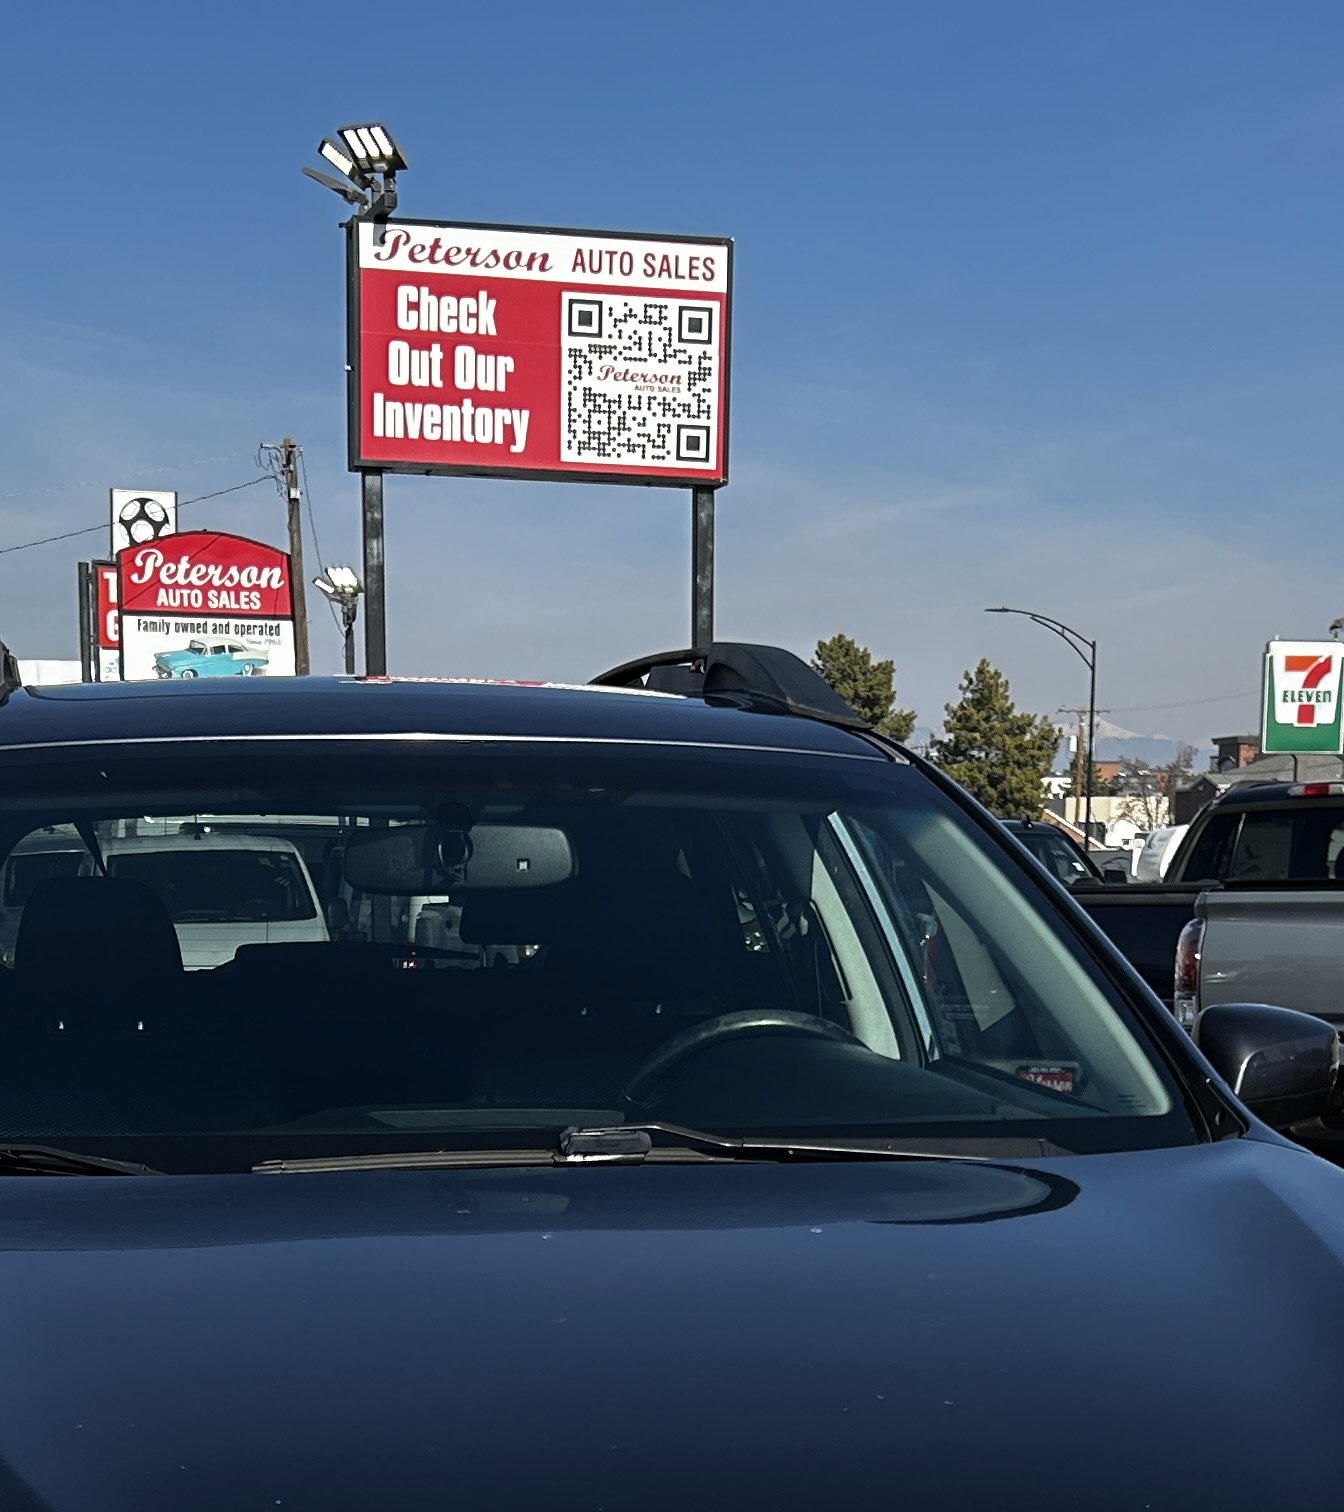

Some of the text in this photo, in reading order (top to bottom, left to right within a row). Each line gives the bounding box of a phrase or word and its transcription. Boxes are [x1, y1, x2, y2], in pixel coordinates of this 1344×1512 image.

[374, 228, 716, 282] Peterson AUTO SALES
[397, 284, 498, 336] Check
[388, 340, 515, 392] Out Our
[597, 364, 683, 385] Peterson
[373, 392, 531, 453] Inventory
[131, 548, 285, 590] Peterson
[157, 588, 262, 610] AUTO SALES
[137, 618, 281, 637] Family owned and operated
[1284, 655, 1332, 724] 7
